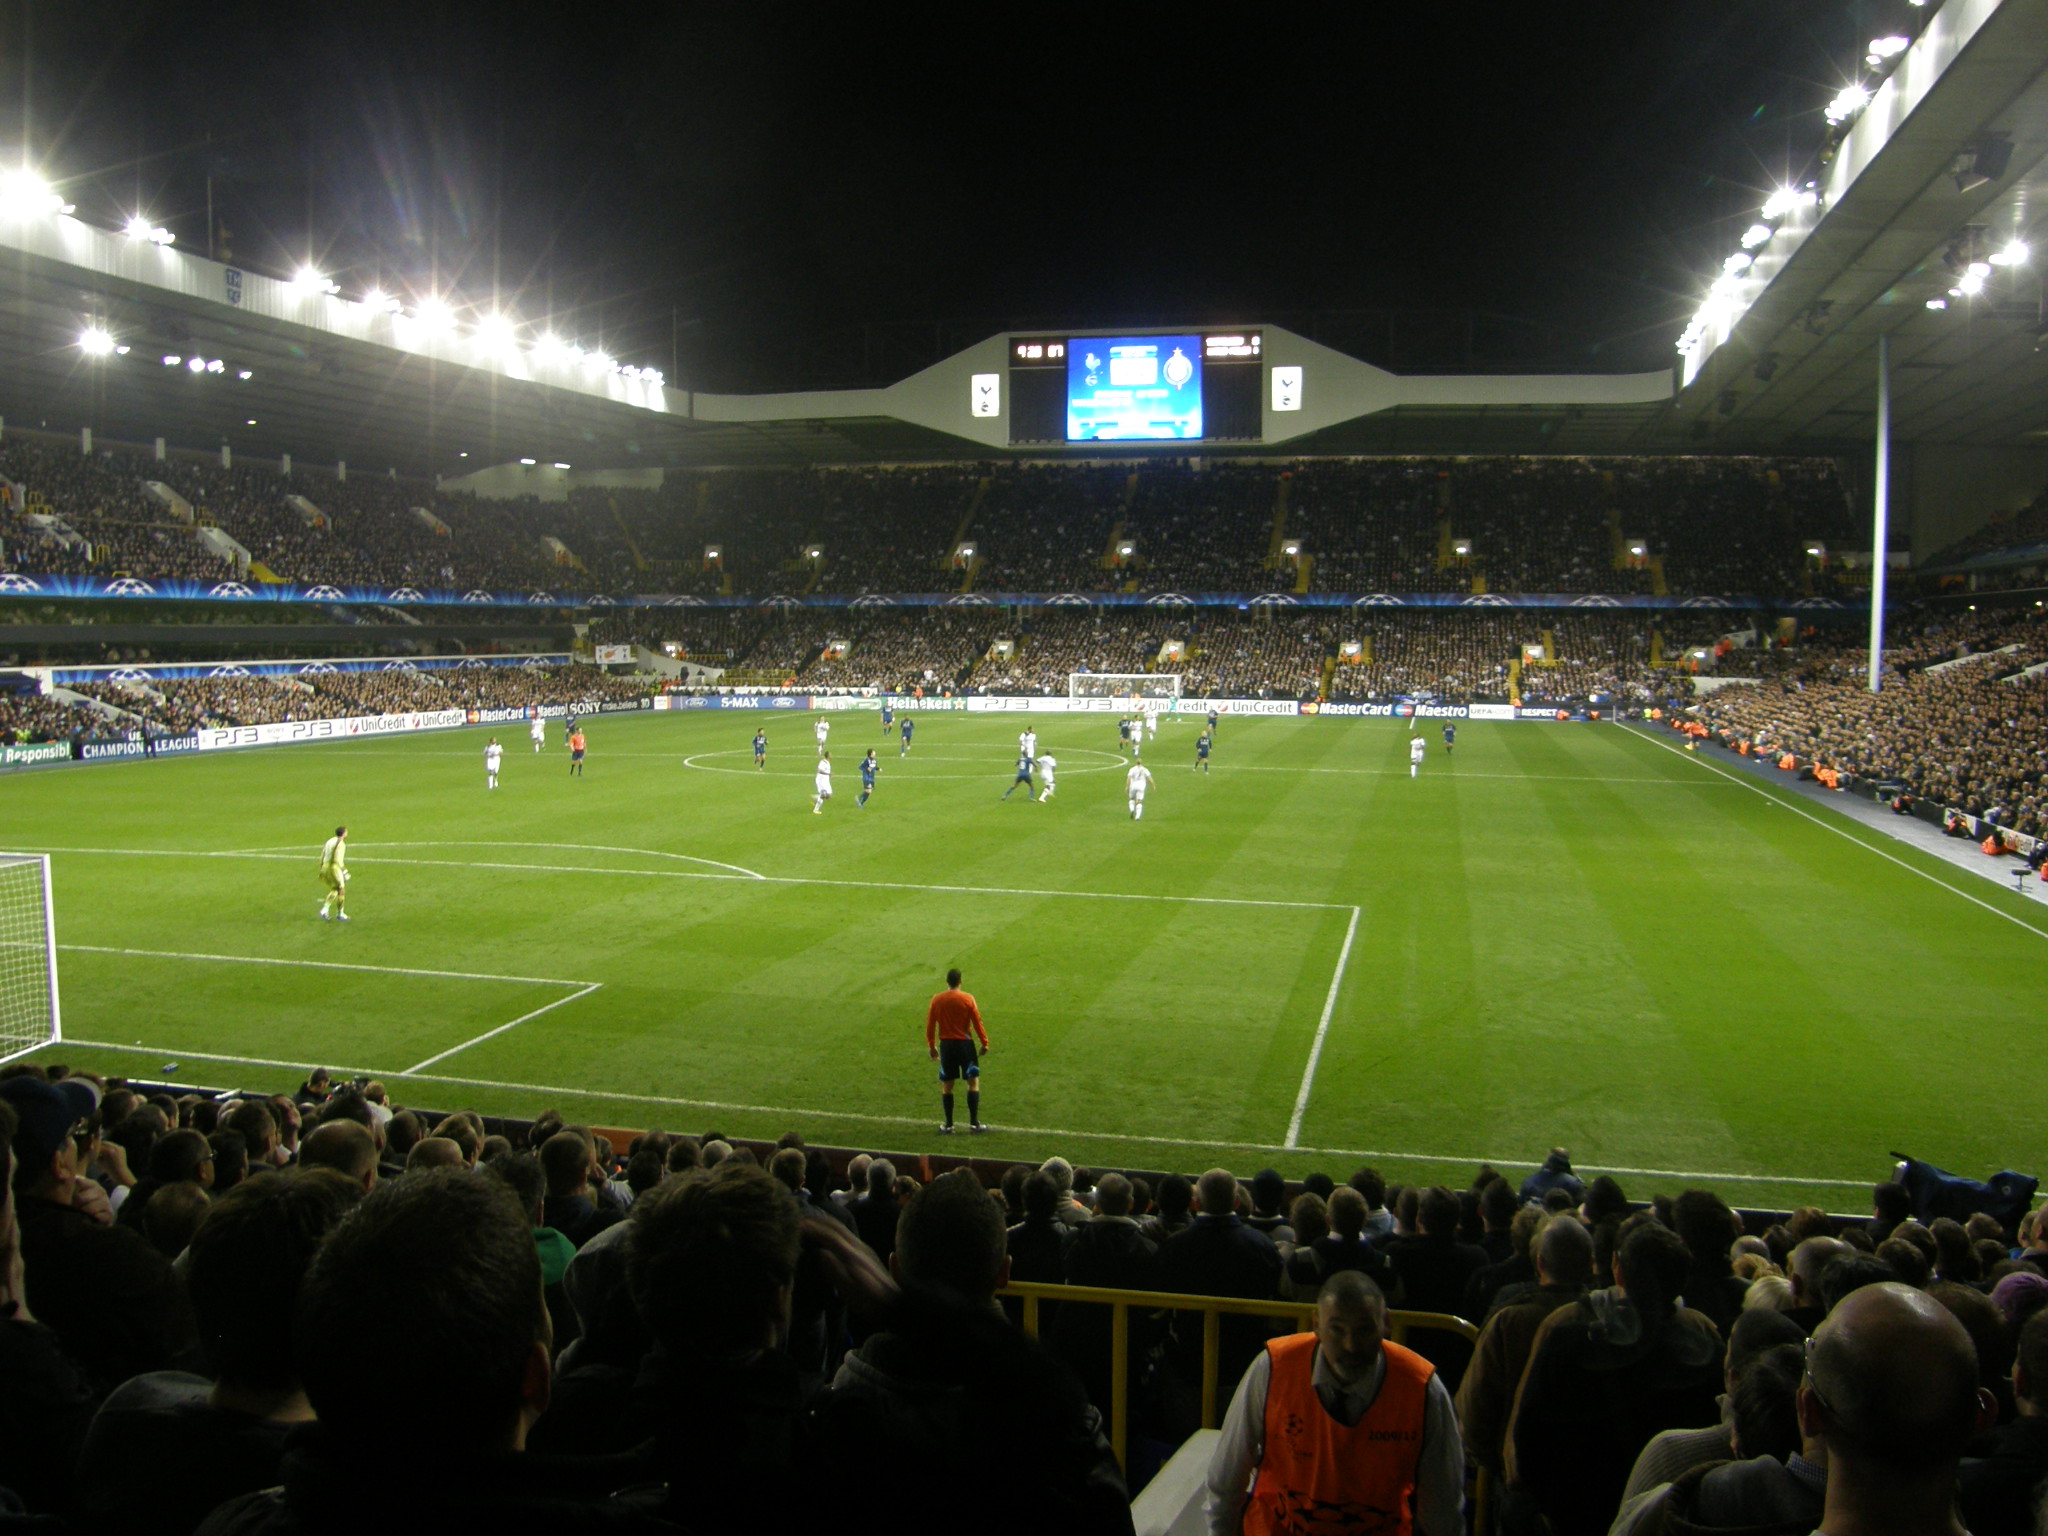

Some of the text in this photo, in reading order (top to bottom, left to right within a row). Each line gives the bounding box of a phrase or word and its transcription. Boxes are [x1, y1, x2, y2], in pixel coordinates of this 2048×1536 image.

[569, 701, 601, 714] SONY
[721, 697, 759, 708] S-MAX
[887, 697, 951, 710] Heineken
[985, 698, 1030, 710] PS3
[1067, 699, 1112, 710] PS3
[1150, 700, 1208, 711] Uniredit
[1232, 701, 1293, 713] UniCredit
[1319, 702, 1393, 716] MasterCard
[480, 707, 524, 723] MasterCard
[537, 705, 566, 718] Maestro
[1414, 704, 1467, 717] Maestro
[1521, 708, 1558, 717] RESPECT
[361, 715, 406, 732] UniCredit
[422, 711, 463, 727] UniCredit
[292, 721, 332, 738] PS3
[214, 727, 258, 746] PS3
[155, 737, 198, 752] LEAGUE
[6, 741, 72, 764] Responsibl
